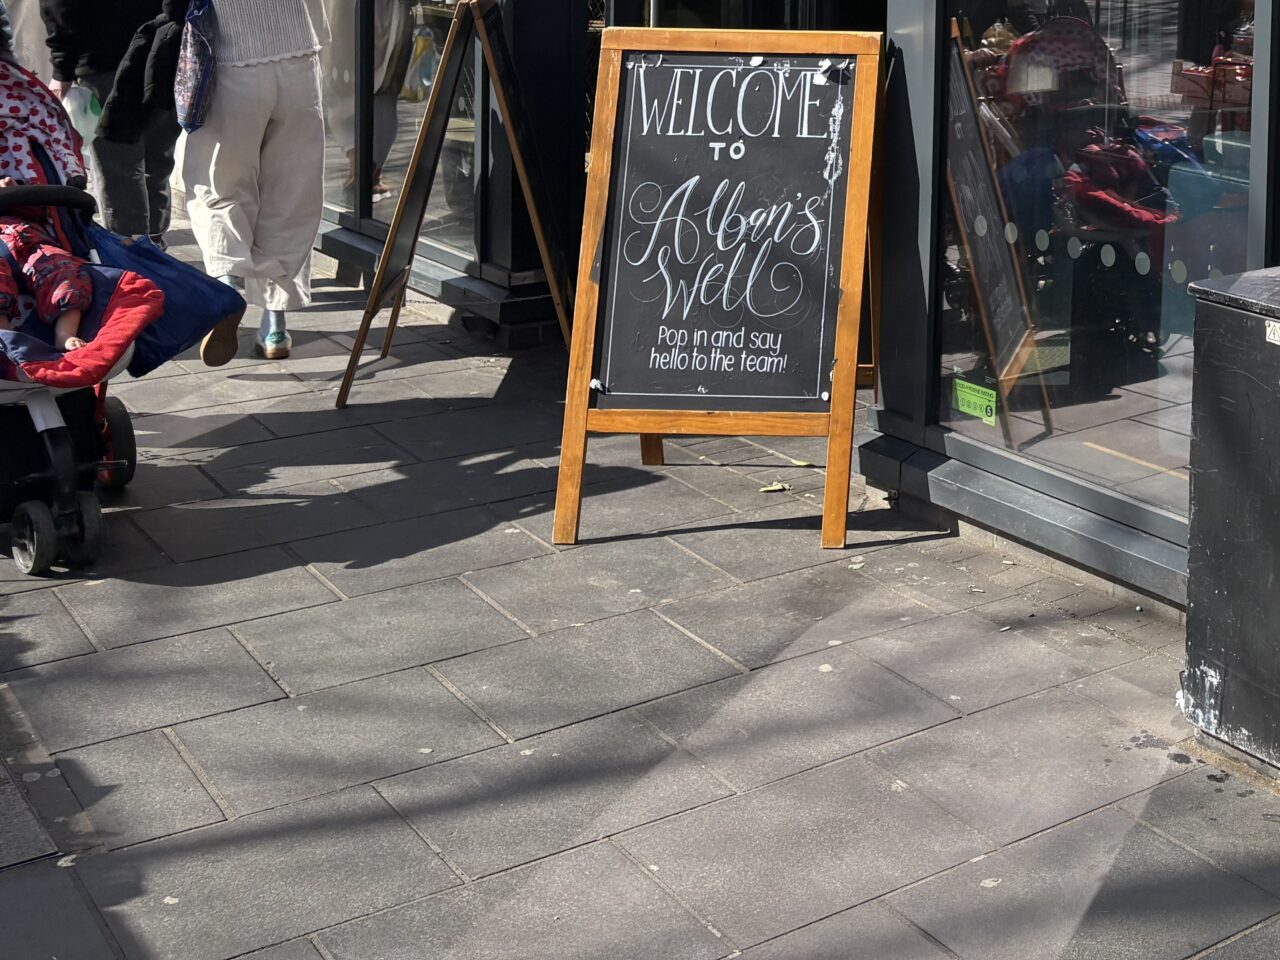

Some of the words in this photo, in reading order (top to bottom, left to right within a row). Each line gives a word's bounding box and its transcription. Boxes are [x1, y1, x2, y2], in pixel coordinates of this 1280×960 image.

[637, 68, 828, 138] WELCOME
[709, 141, 746, 161] TO
[624, 175, 825, 265] Alban's
[642, 238, 803, 320] Well
[649, 347, 689, 370] hello
[691, 348, 707, 371] to
[710, 348, 735, 372] the
[740, 350, 788, 373] team!
[657, 325, 688, 349] Pop
[693, 329, 708, 347] in
[711, 327, 745, 348] and
[749, 332, 782, 356] say
